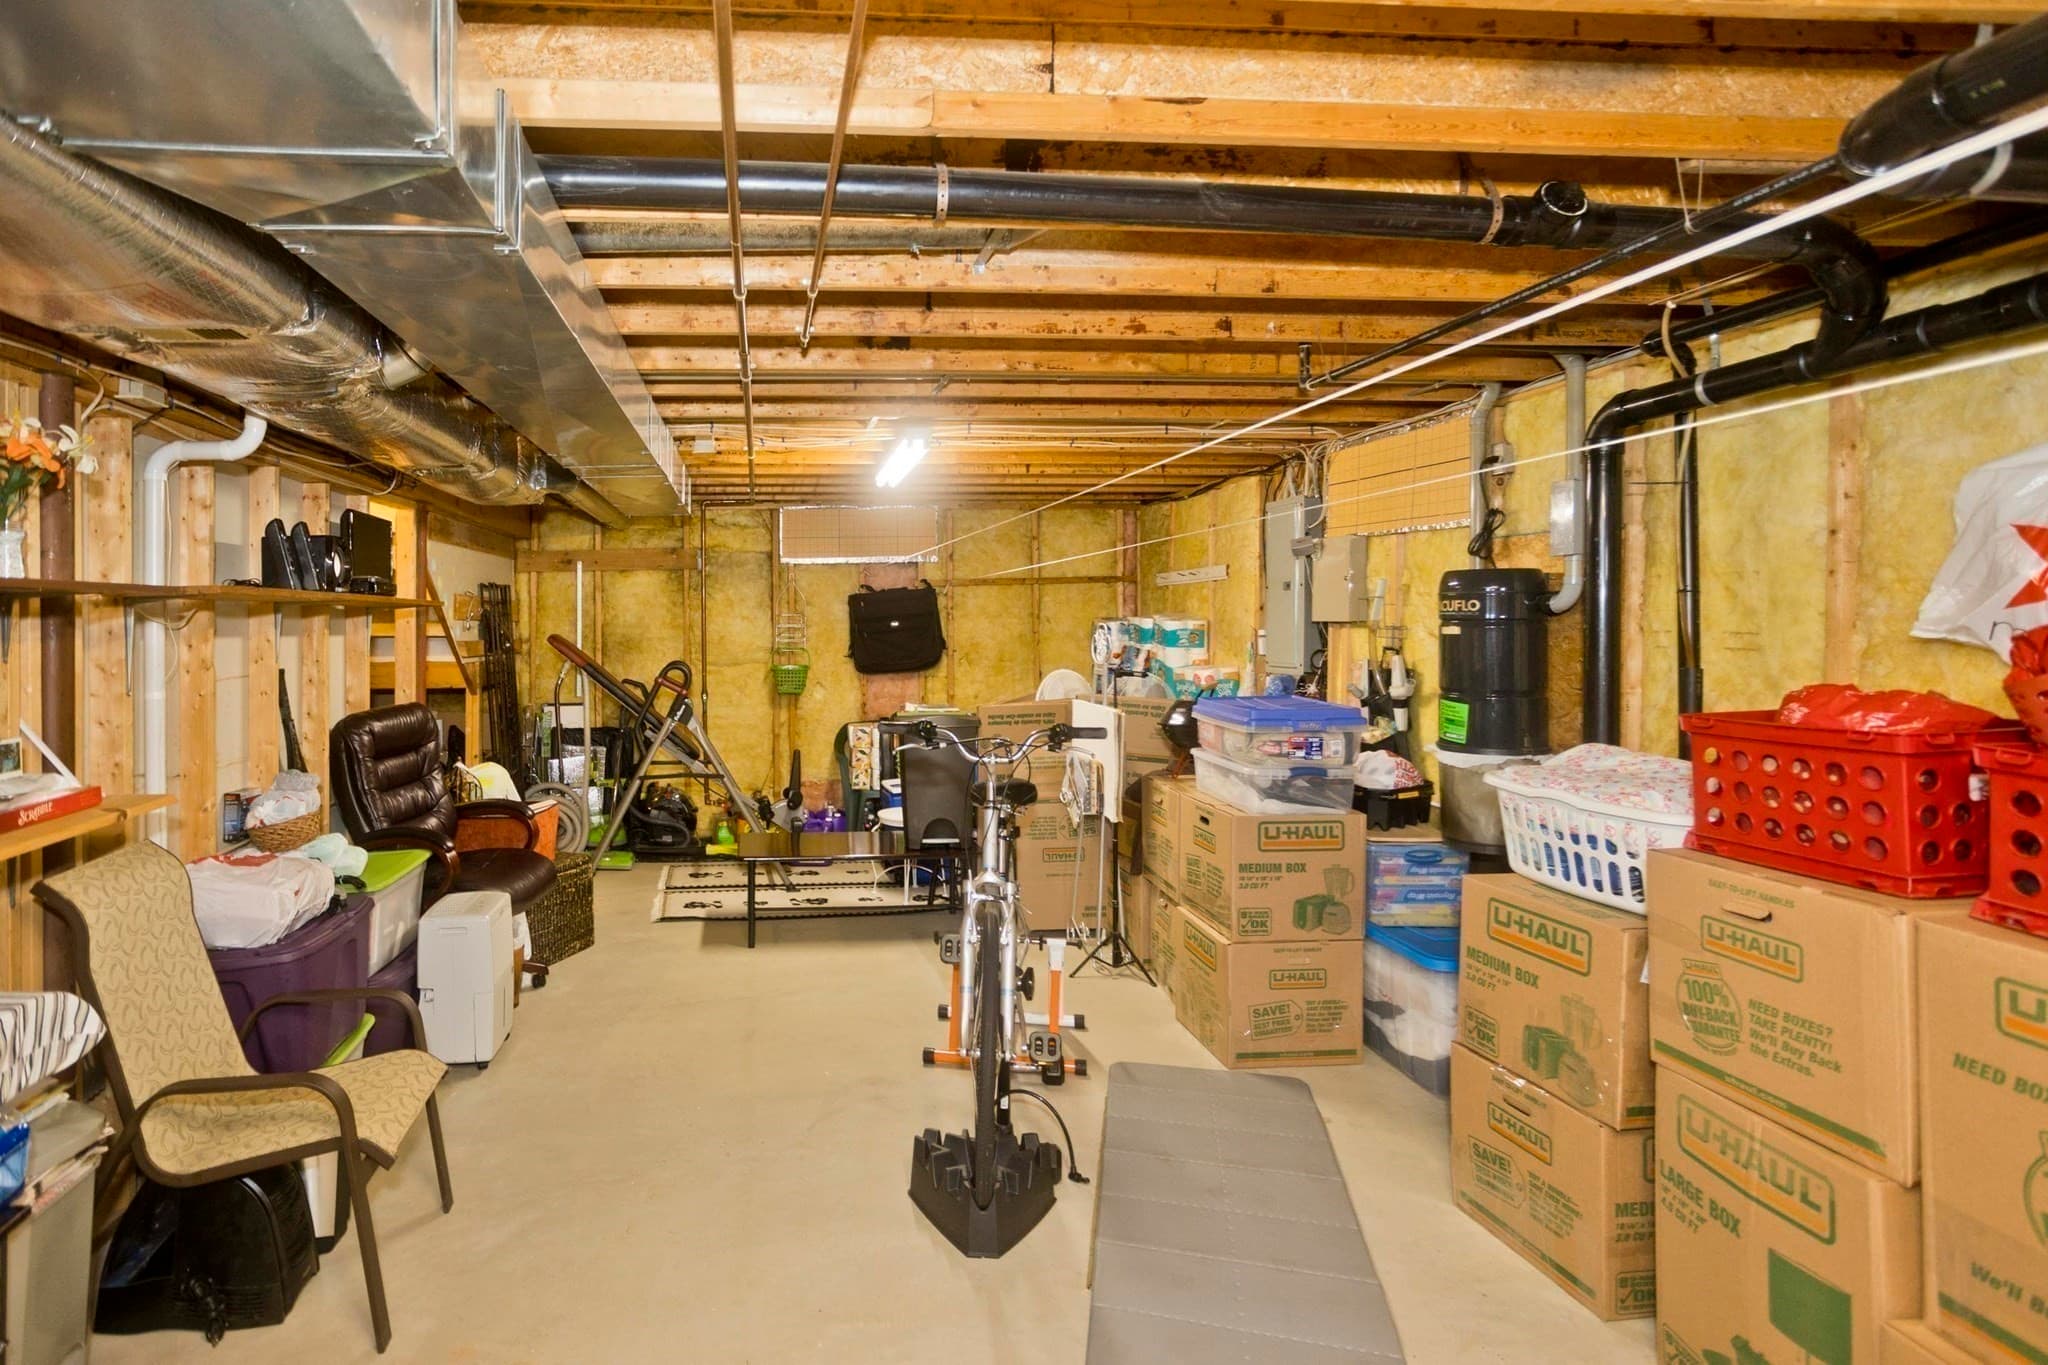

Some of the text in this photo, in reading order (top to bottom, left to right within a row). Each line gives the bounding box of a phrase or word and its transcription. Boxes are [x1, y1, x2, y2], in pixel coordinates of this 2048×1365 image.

[1263, 826, 1340, 840] U-HAUL
[1238, 863, 1307, 873] MEDIUM BOX
[1493, 906, 1585, 957] U-HAUL
[1706, 922, 1796, 966] U-HAUL
[1272, 972, 1324, 982] U-HAUL
[1466, 945, 1511, 977] MEDIUM
[1515, 966, 1540, 989] BOX
[1252, 1003, 1291, 1019] SAVE!
[1683, 979, 1730, 1007] 100%
[1748, 998, 1833, 1038] NEED BOXES?
[1750, 1013, 1833, 1055] TAKE PLENTY!
[1749, 1028, 1777, 1048] We'll
[1781, 1040, 1805, 1060] Buy
[1808, 1051, 1843, 1074] Back
[1750, 1042, 1769, 1059] the
[1772, 1052, 1815, 1078] Extras.
[1953, 1052, 2007, 1086] NEED
[1492, 1108, 1549, 1153] U-HAUL
[1472, 1142, 1512, 1174] SAVE!
[1686, 1107, 1822, 1213] U-HAUL
[1659, 1159, 1704, 1209] LARGE
[1709, 1198, 1741, 1238] BOX
[1971, 1262, 2023, 1302] We'll
